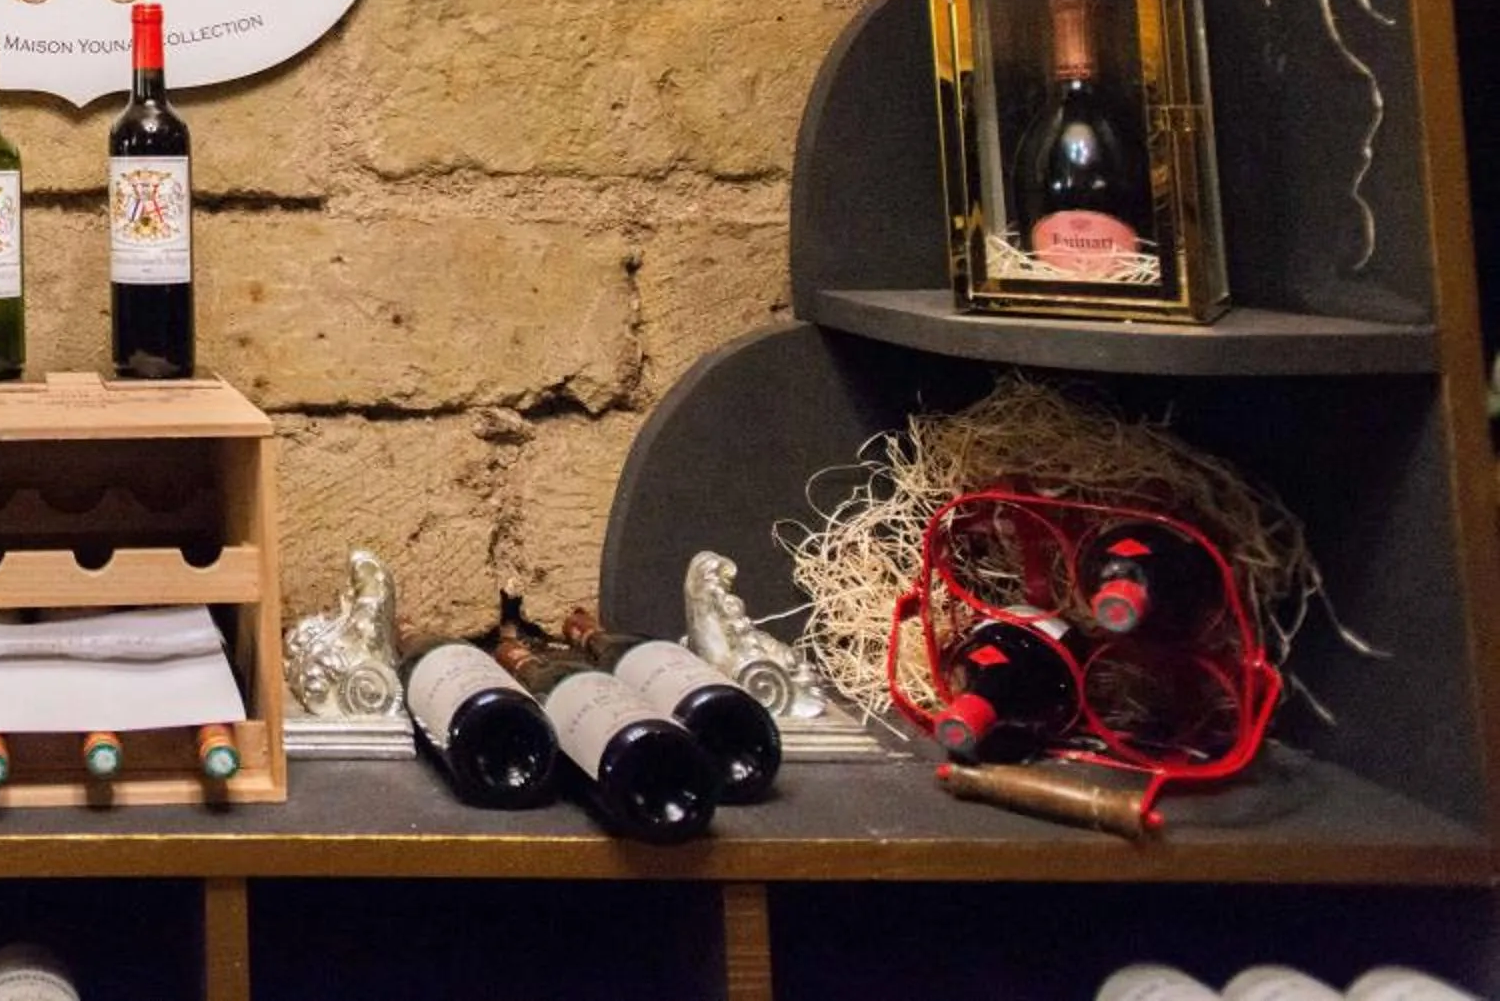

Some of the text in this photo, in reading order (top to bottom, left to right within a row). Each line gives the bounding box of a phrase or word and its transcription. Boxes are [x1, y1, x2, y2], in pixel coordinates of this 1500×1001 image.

[4, 34, 74, 55] MAISON
[77, 37, 132, 55] YOUNA
[162, 14, 265, 46] OLLECTION
